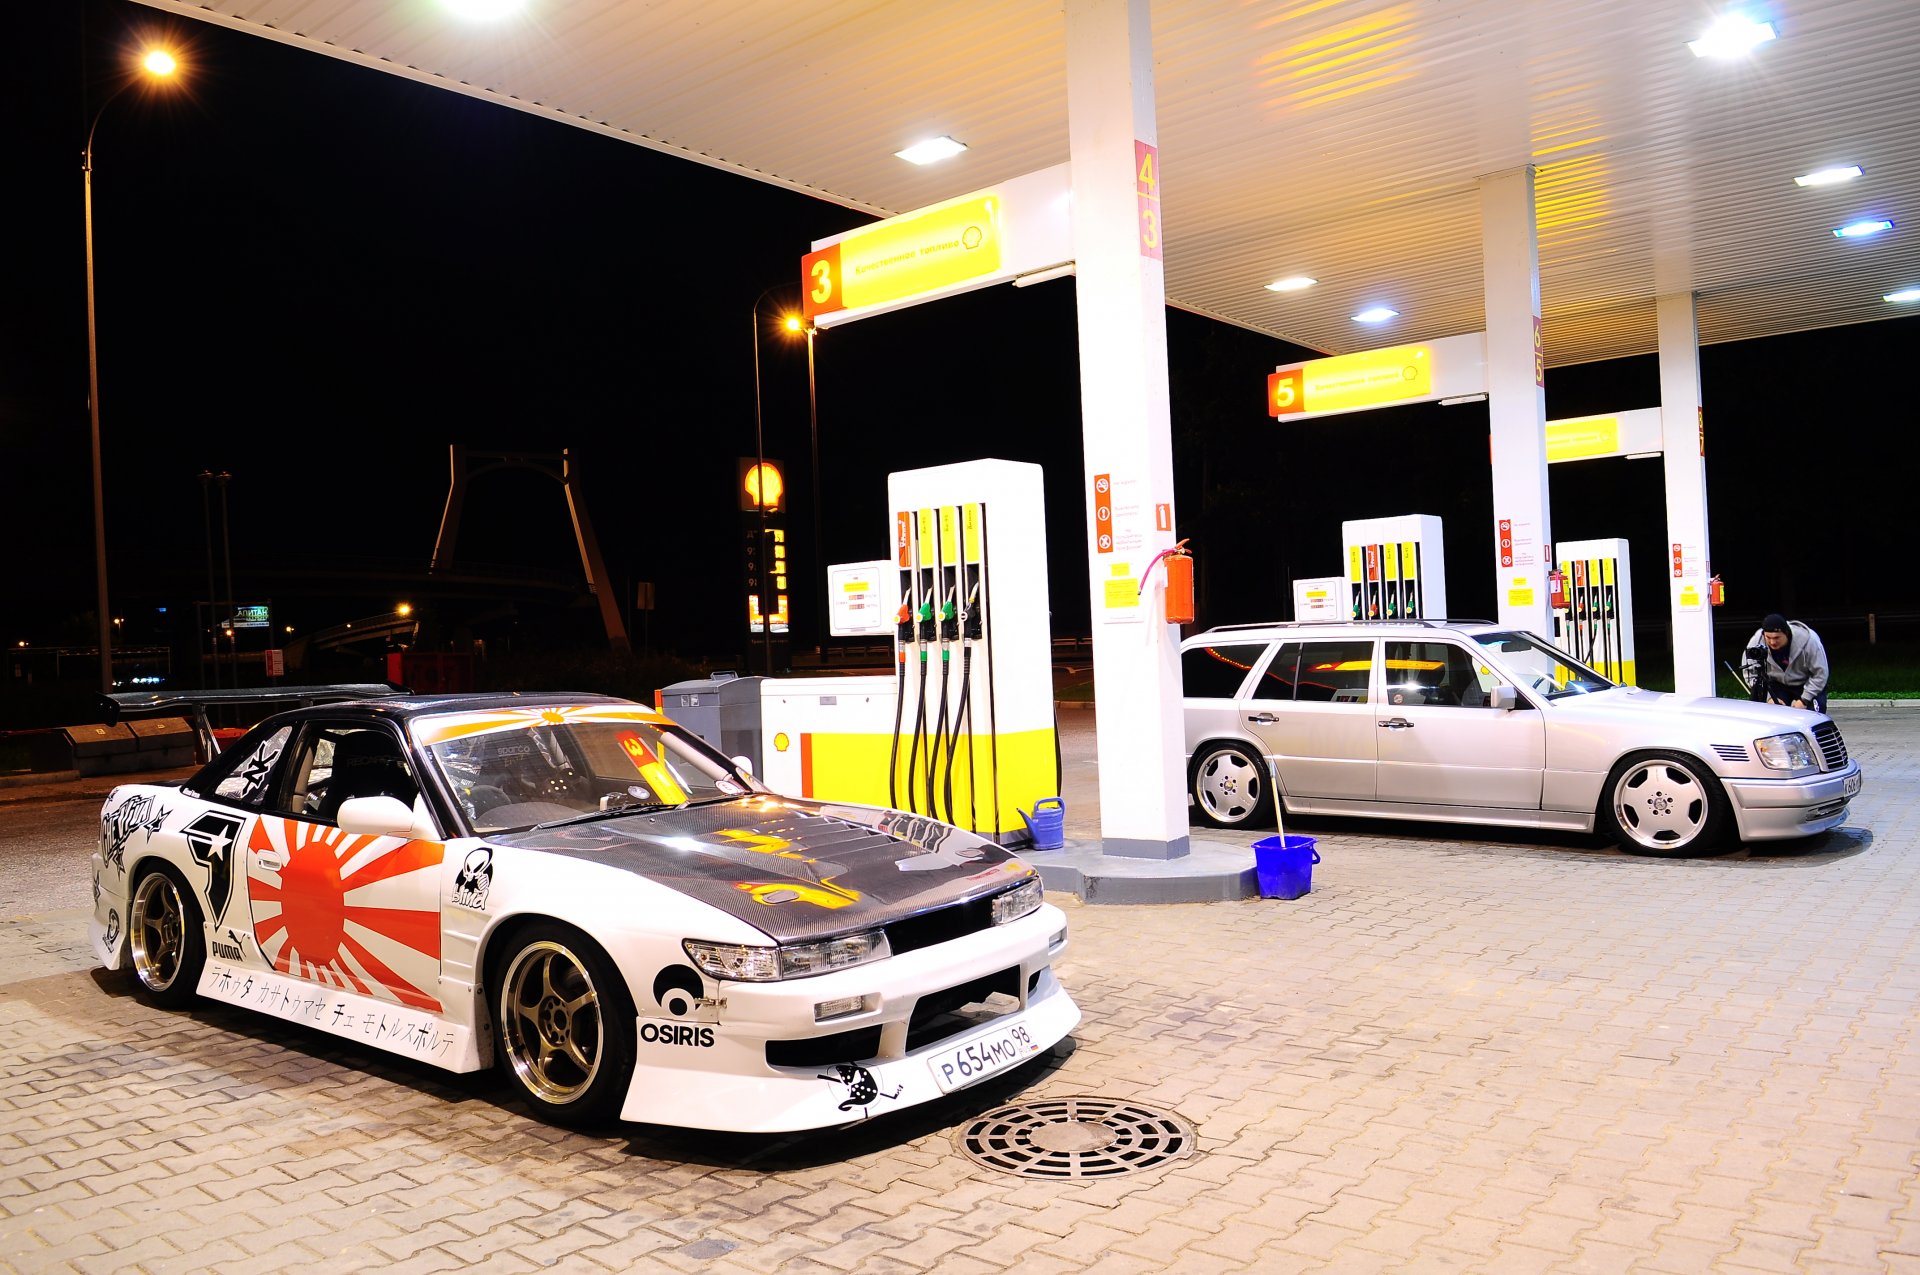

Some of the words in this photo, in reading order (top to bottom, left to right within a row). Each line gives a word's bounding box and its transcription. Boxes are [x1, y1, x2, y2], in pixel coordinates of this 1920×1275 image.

[1139, 153, 1156, 191] 4
[1143, 209, 1158, 249] 3
[811, 259, 832, 304] 3
[1534, 325, 1541, 348] 6
[1536, 358, 1542, 382] 5
[1276, 378, 1295, 407] 5
[497, 745, 531, 756] sparco
[452, 884, 489, 911] blind
[212, 941, 243, 962] PUMA
[640, 1023, 714, 1047] OSIRIS
[1011, 1026, 1031, 1046] 98
